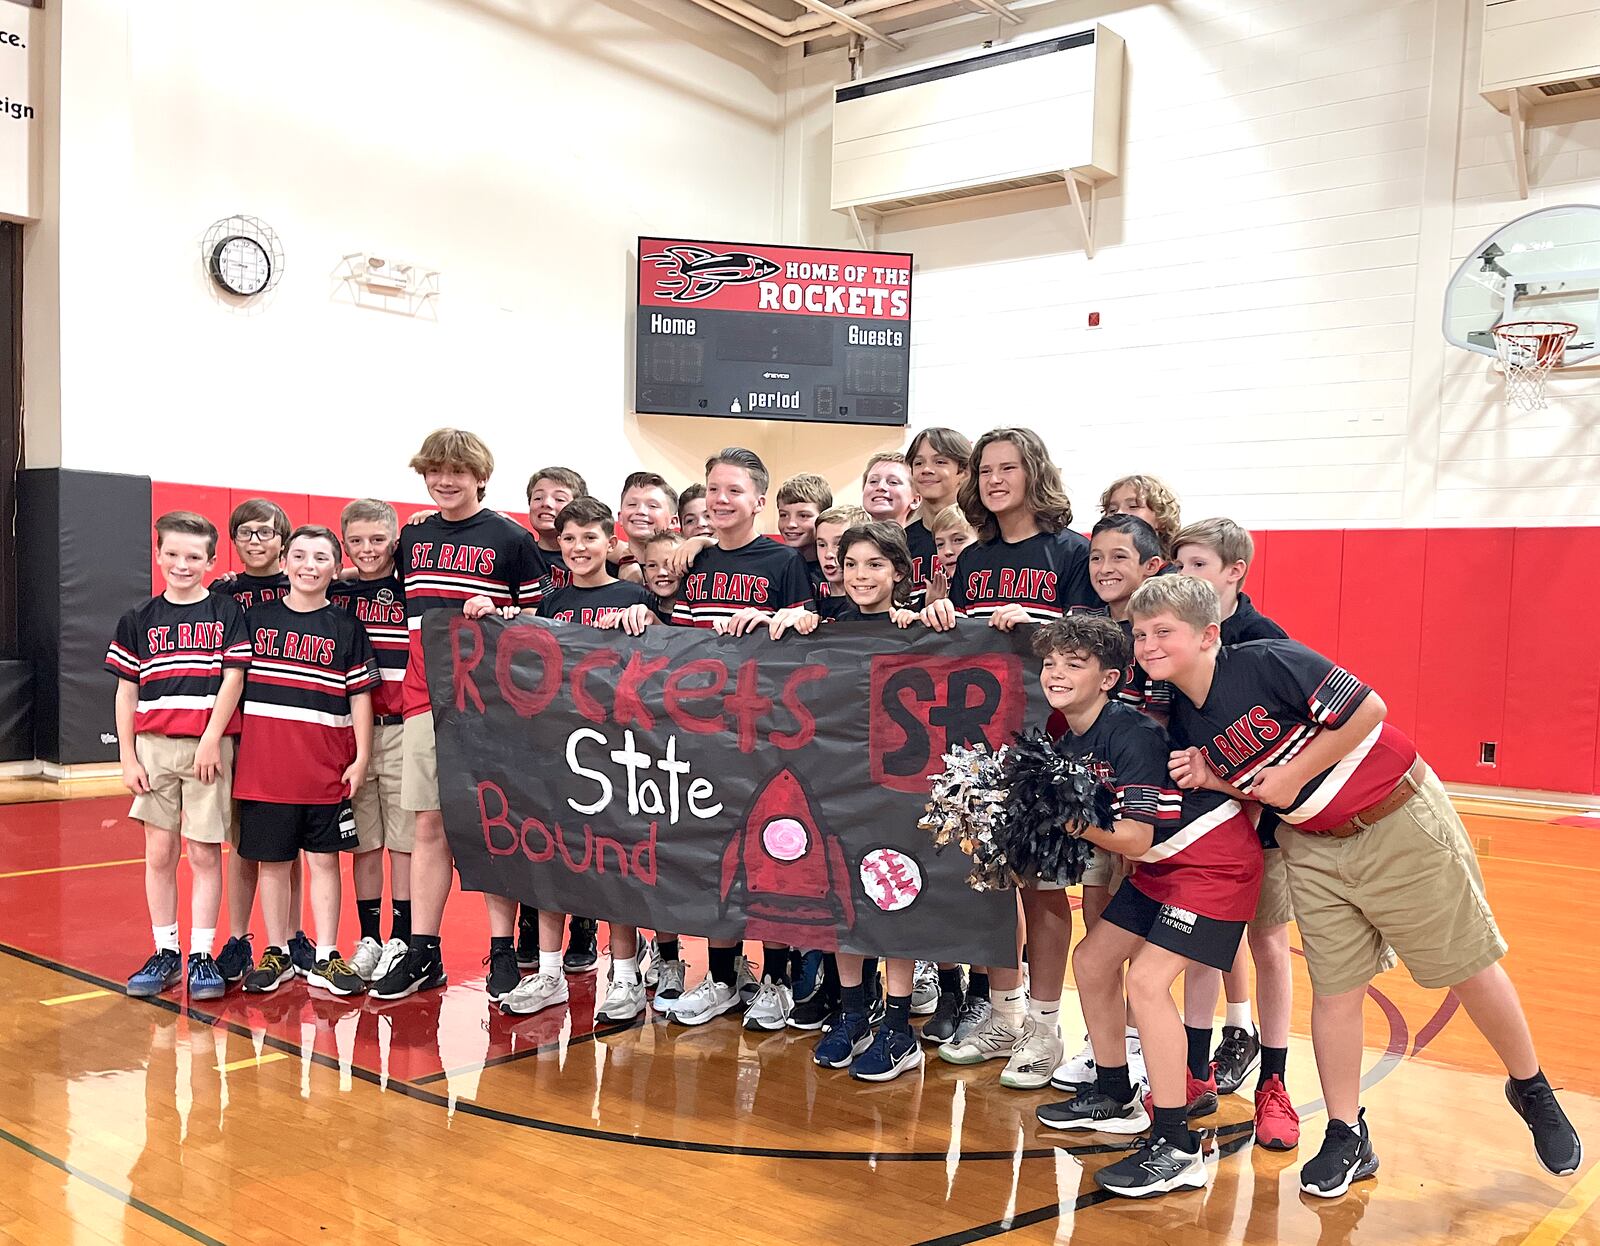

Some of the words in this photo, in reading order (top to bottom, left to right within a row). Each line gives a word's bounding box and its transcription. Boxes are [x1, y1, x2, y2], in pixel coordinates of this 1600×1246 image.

[785, 262, 838, 281] HOME
[844, 266, 868, 283] OF
[872, 267, 909, 286] THE
[758, 282, 908, 317] ROCKETS
[651, 314, 696, 335] Home
[848, 325, 903, 347] Guests
[748, 391, 800, 411] period
[411, 542, 434, 569] ST.
[437, 543, 496, 575] RAYS
[685, 574, 710, 601] ST.
[712, 572, 769, 602] RAYS
[966, 571, 994, 601] ST.
[998, 568, 1057, 601] RAYS
[356, 597, 405, 623] RAYS
[148, 626, 173, 653] ST.
[178, 621, 223, 648] RAYS
[254, 628, 279, 656] ST.
[283, 631, 335, 665] RAYS
[1213, 705, 1281, 767] RAYS
[565, 728, 724, 824] State
[476, 779, 657, 886] Bound
